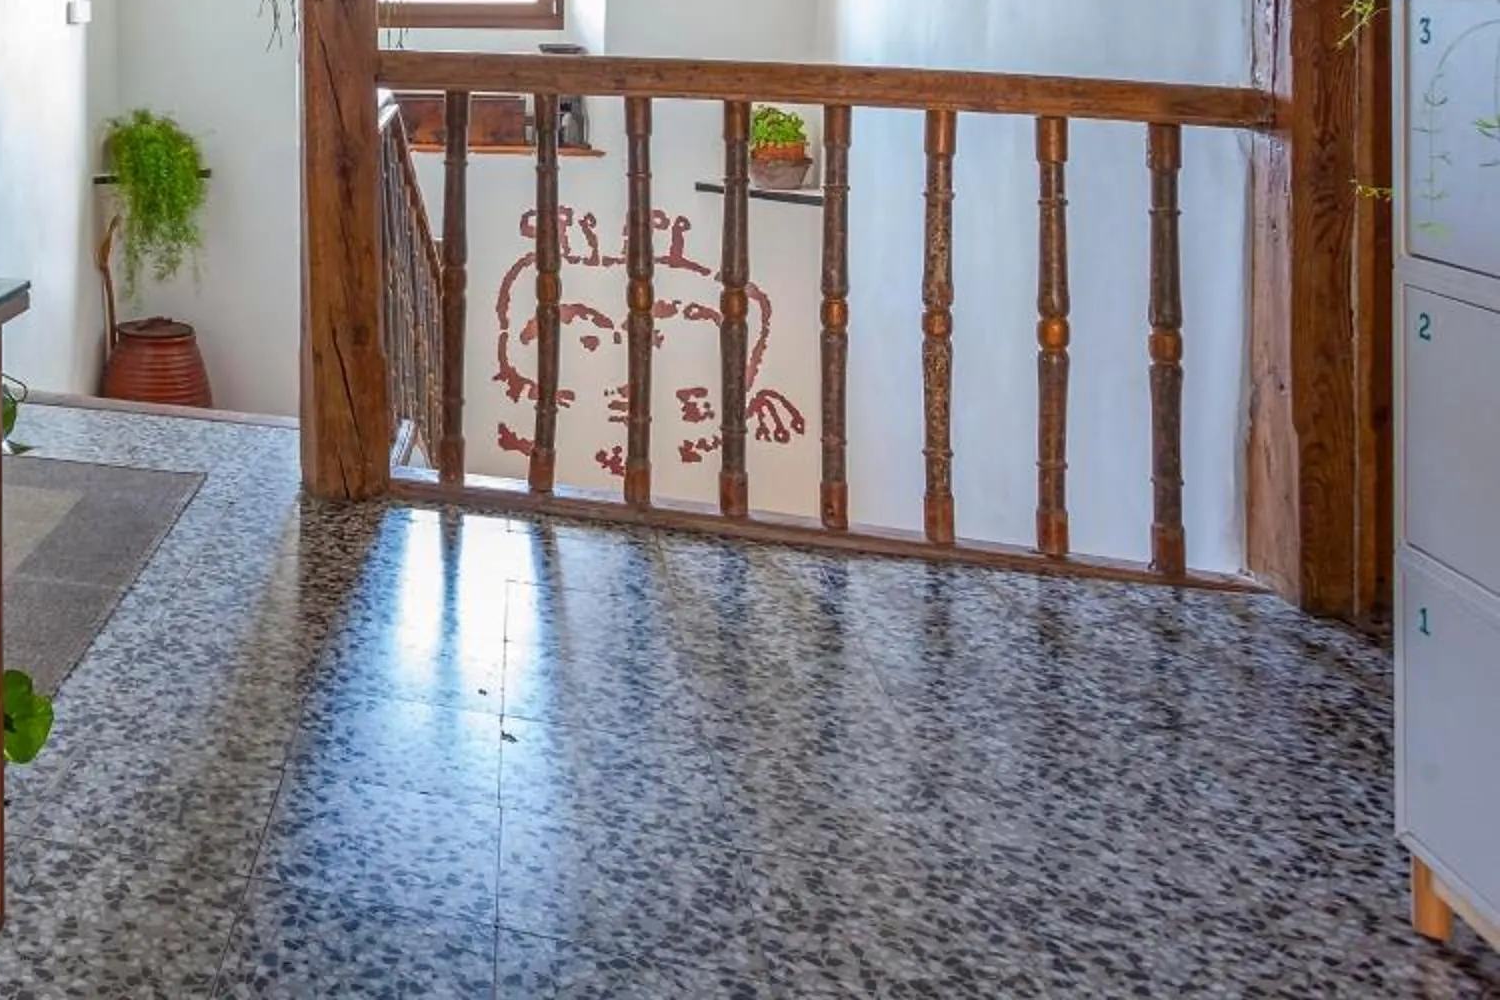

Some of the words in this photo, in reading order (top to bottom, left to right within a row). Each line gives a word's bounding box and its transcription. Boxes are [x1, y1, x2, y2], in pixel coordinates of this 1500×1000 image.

[1419, 17, 1431, 45] 3
[1419, 313, 1431, 341] 2
[1419, 608, 1431, 635] 1
